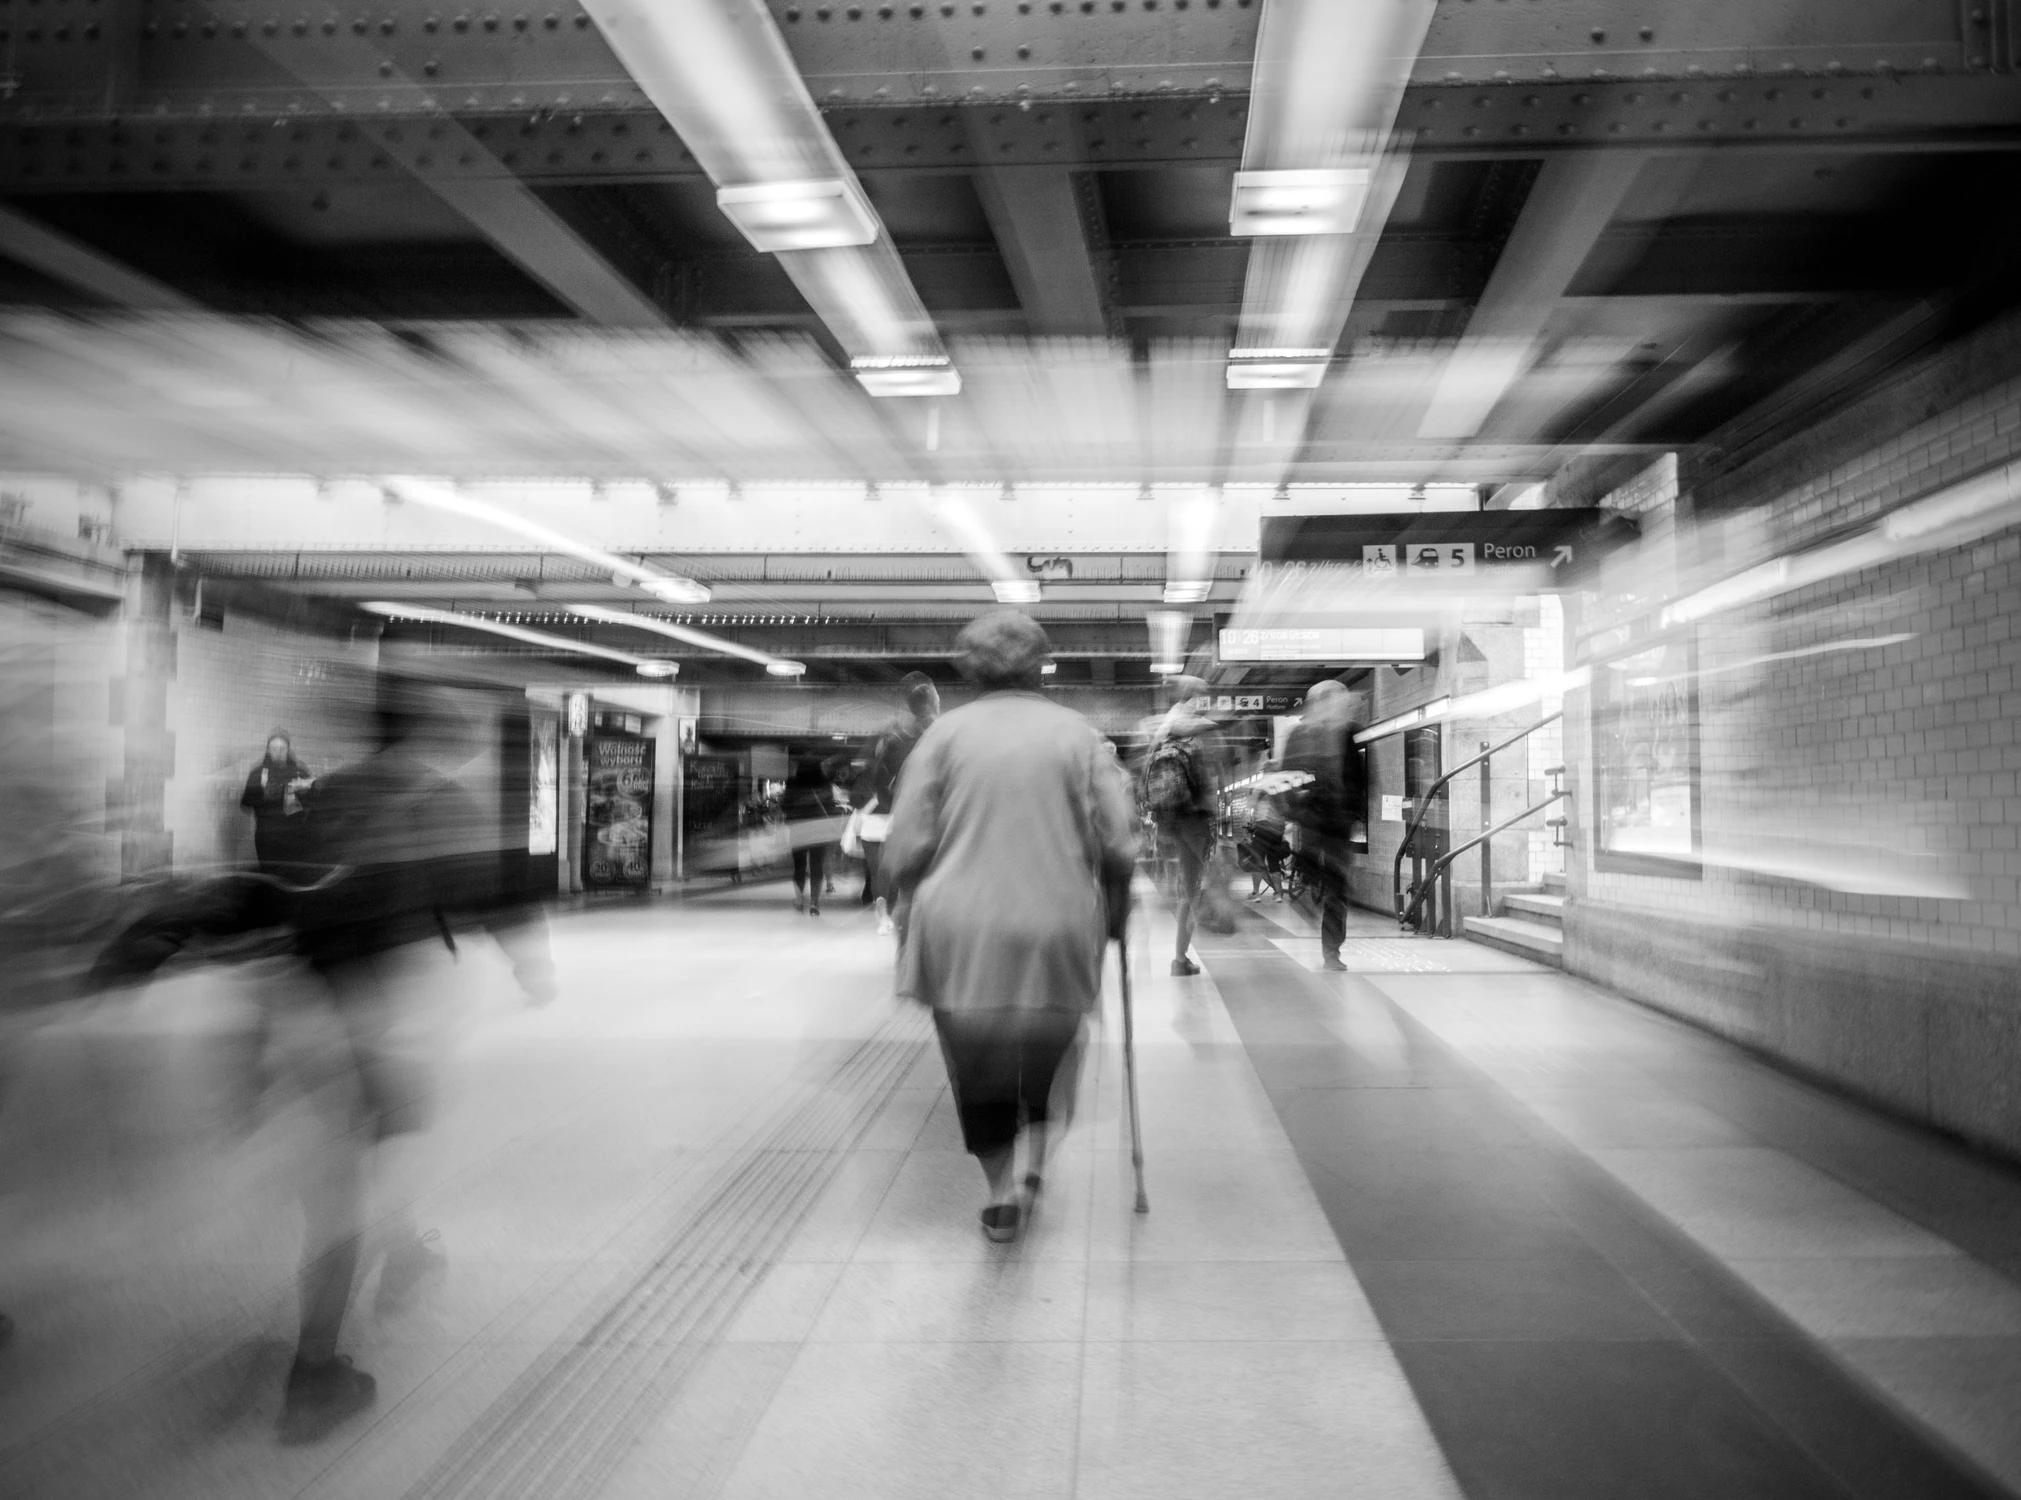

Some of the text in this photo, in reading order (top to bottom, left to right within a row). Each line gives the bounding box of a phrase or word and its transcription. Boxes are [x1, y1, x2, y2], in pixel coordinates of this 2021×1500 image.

[1451, 542, 1536, 567] 5 Peron
[1252, 695, 1288, 708] 4 Peron
